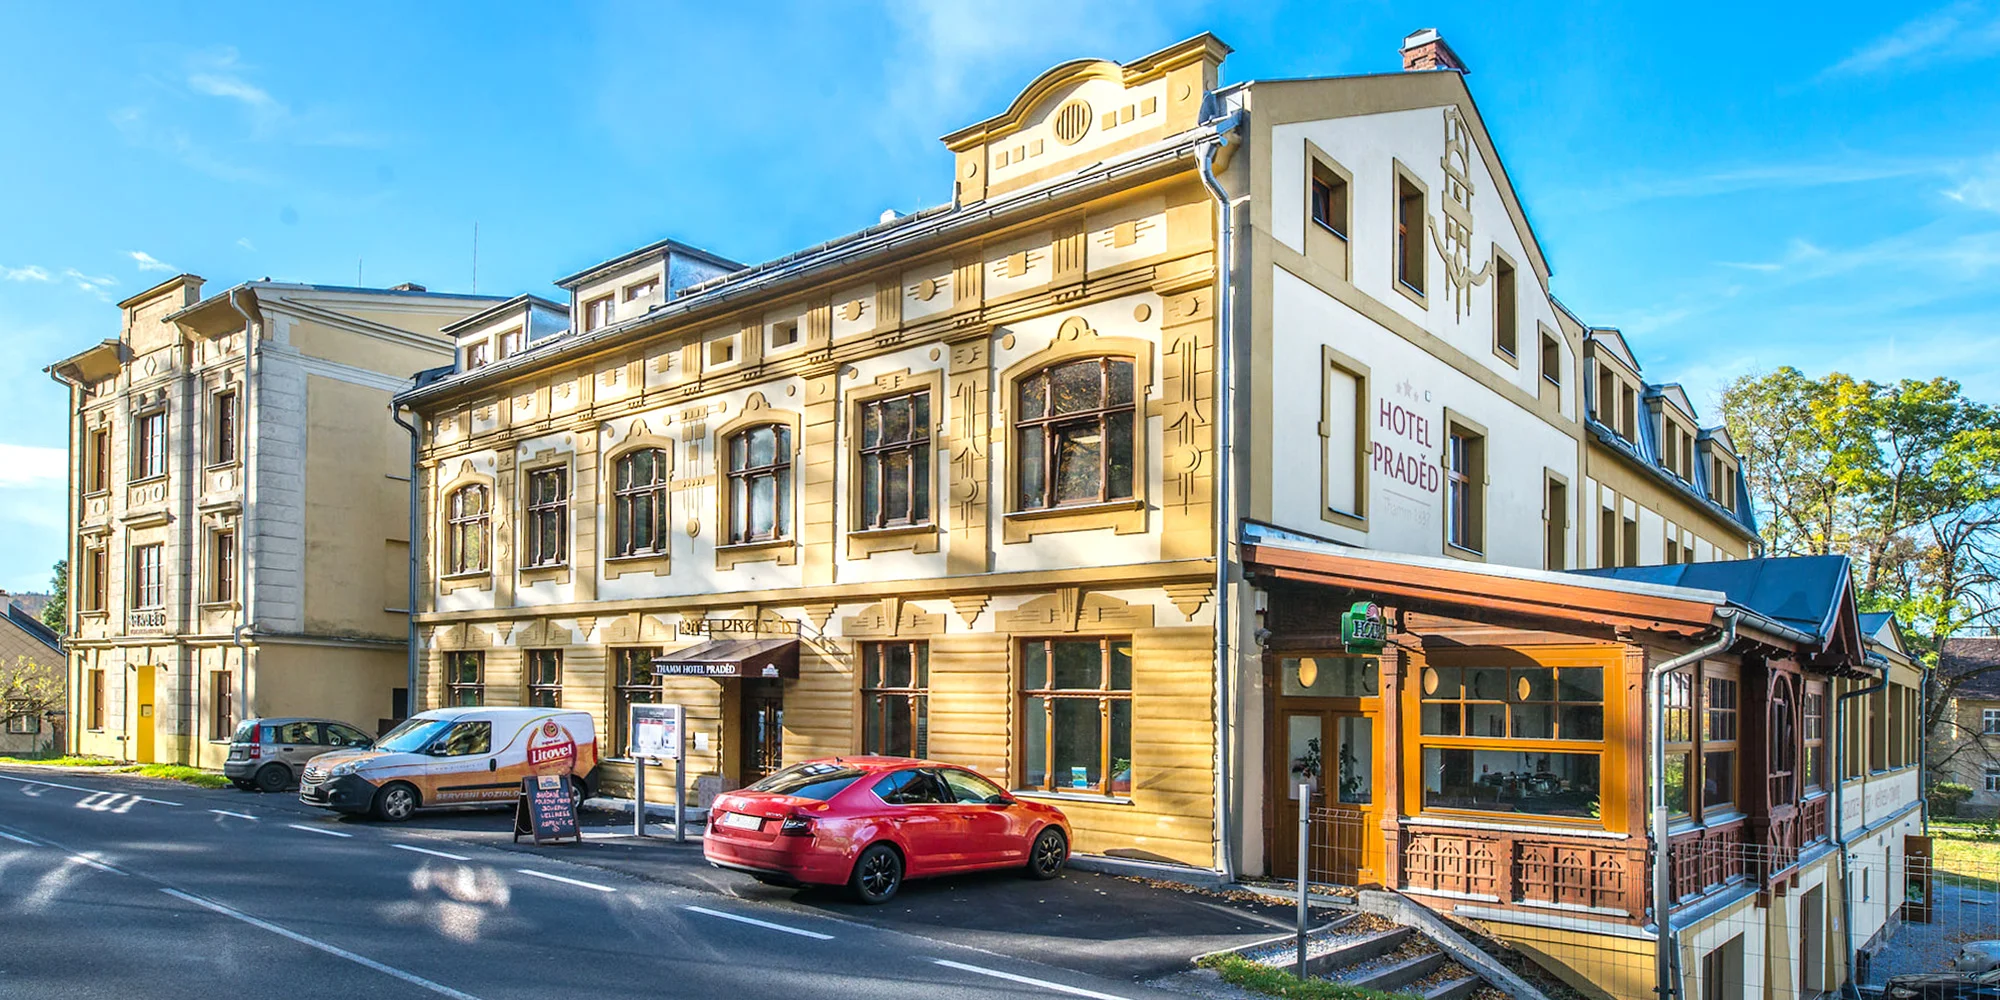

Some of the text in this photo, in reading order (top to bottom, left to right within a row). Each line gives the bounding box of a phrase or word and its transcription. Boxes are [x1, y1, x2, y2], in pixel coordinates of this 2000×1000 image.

[1380, 398, 1432, 448] HOTEL
[1374, 441, 1438, 493] PRADĚD
[655, 664, 682, 674] THAMM
[683, 664, 705, 675] HOTEL
[532, 743, 573, 764] Litovel
[481, 790, 520, 799] VOZIDLO
